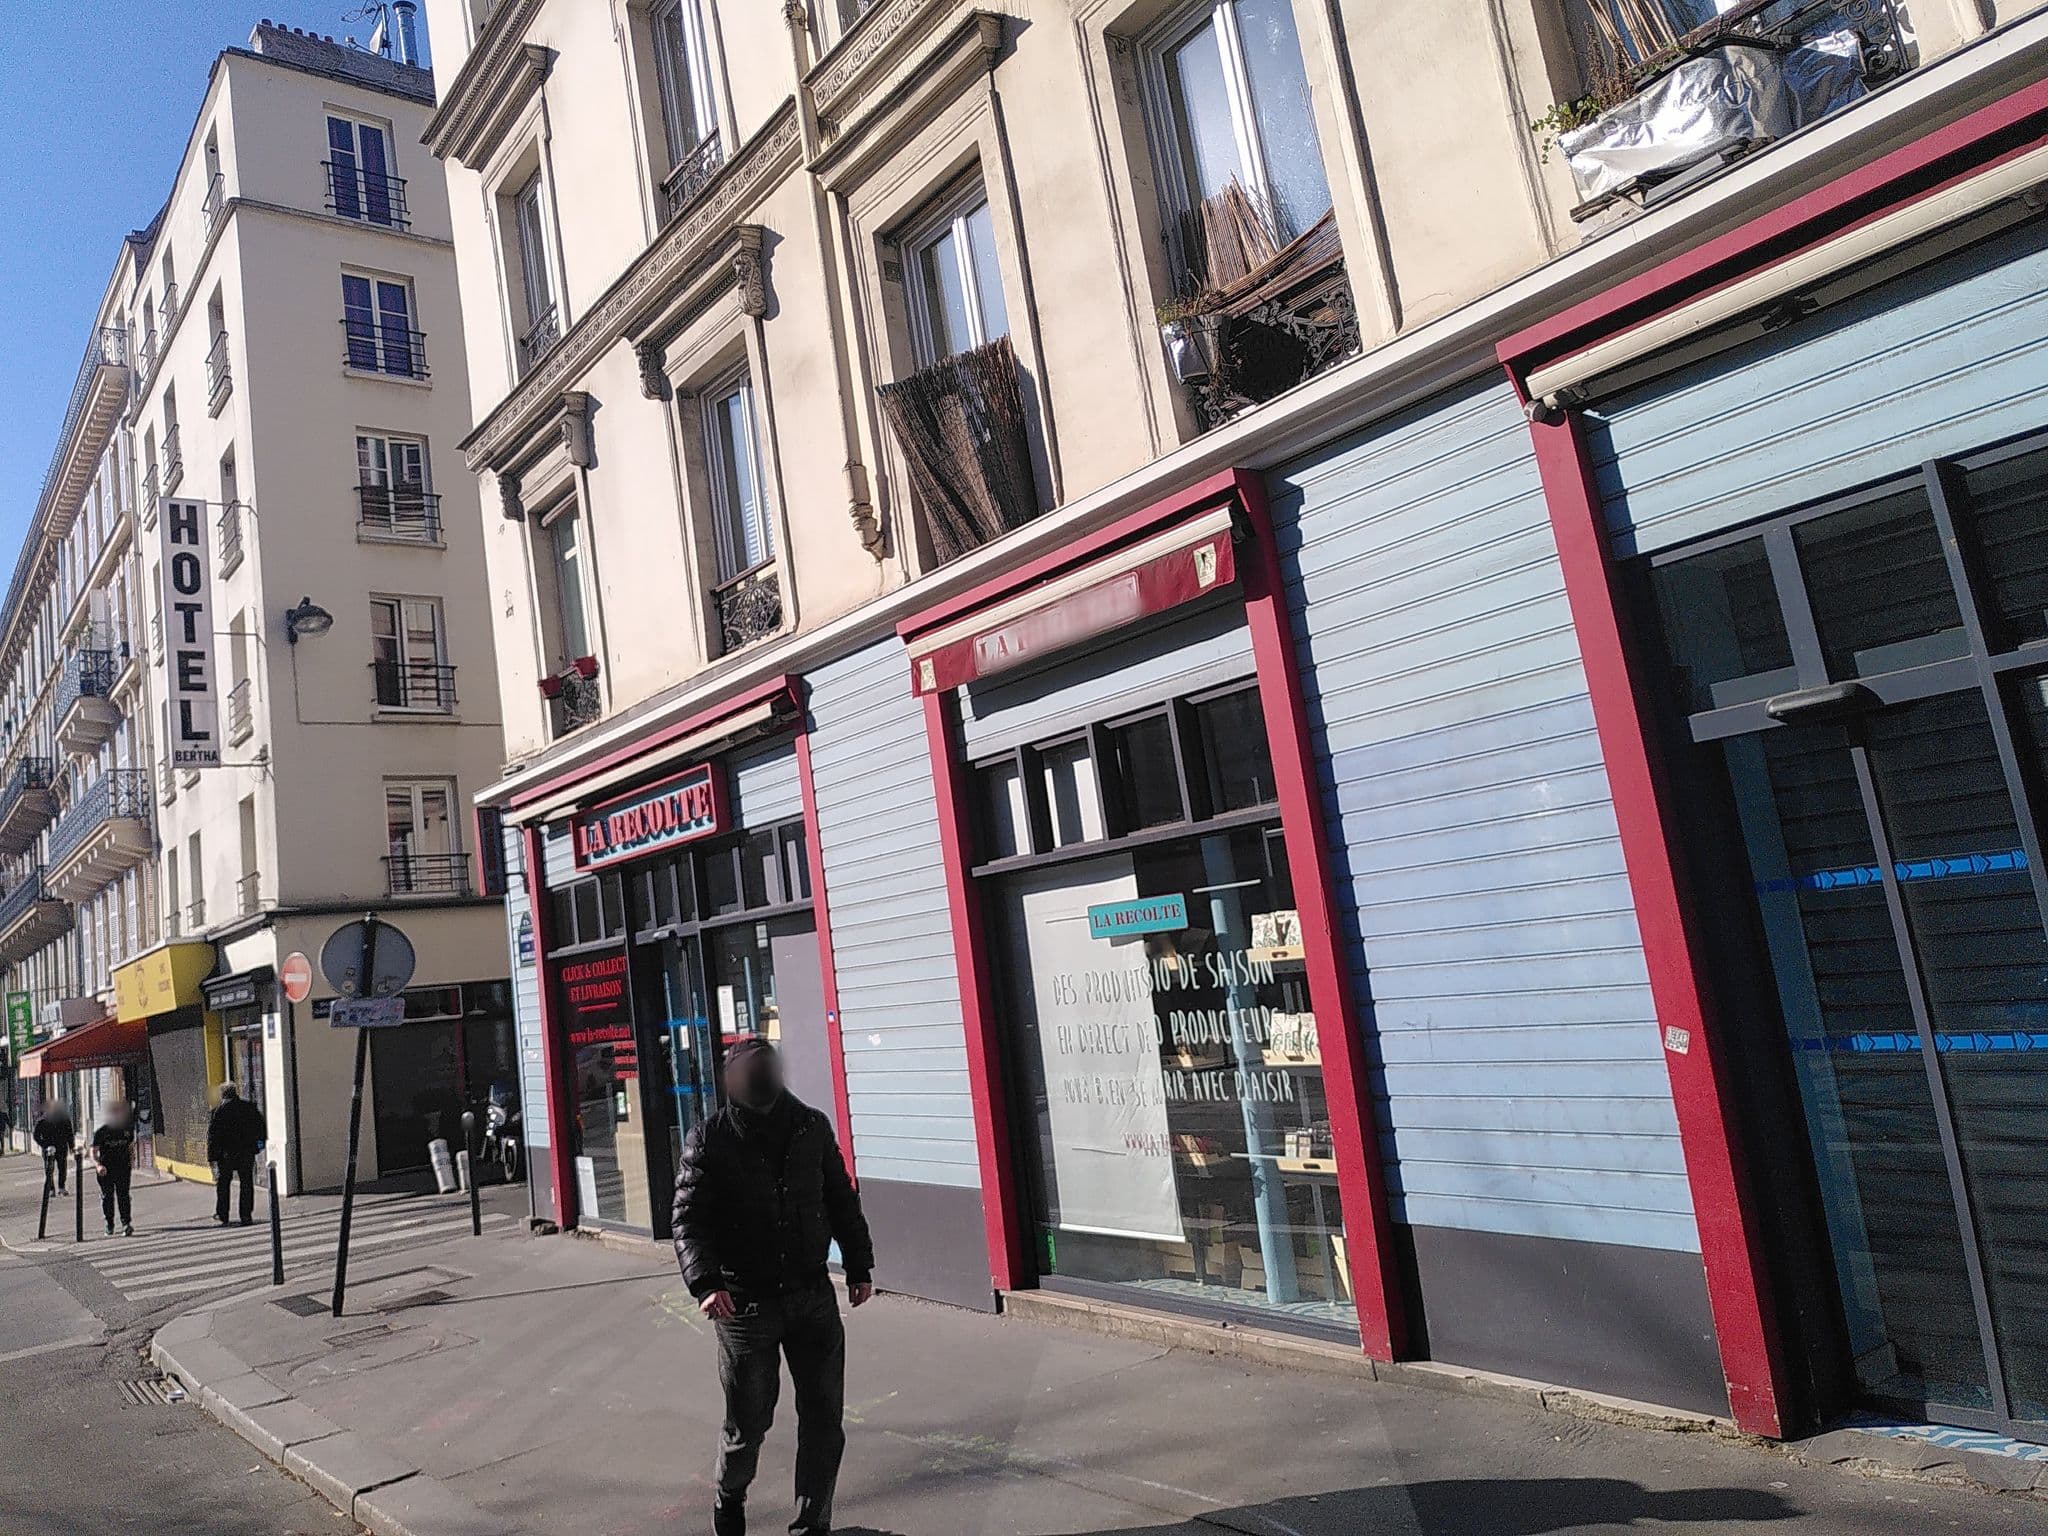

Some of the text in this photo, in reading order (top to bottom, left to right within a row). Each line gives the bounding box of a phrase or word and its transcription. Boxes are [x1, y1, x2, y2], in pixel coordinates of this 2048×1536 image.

[168, 503, 210, 741] HOTEL
[175, 750, 218, 762] BERTHA
[578, 783, 710, 856] LA RECOLTE
[1094, 903, 1182, 929] LA RECOLTE
[562, 956, 628, 983] CLICK & COLLECT
[1053, 973, 1077, 1006] DES
[1085, 964, 1151, 1004] PRODUITS
[1176, 953, 1200, 990] DE
[1205, 950, 1275, 989] SAISON
[580, 980, 622, 1001] LIVRAISON
[1057, 1024, 1074, 1055] EN
[1078, 1023, 1130, 1055] DIRECT
[1191, 1070, 1230, 1102] AVEC
[1234, 1069, 1294, 1103] PLAISIR
